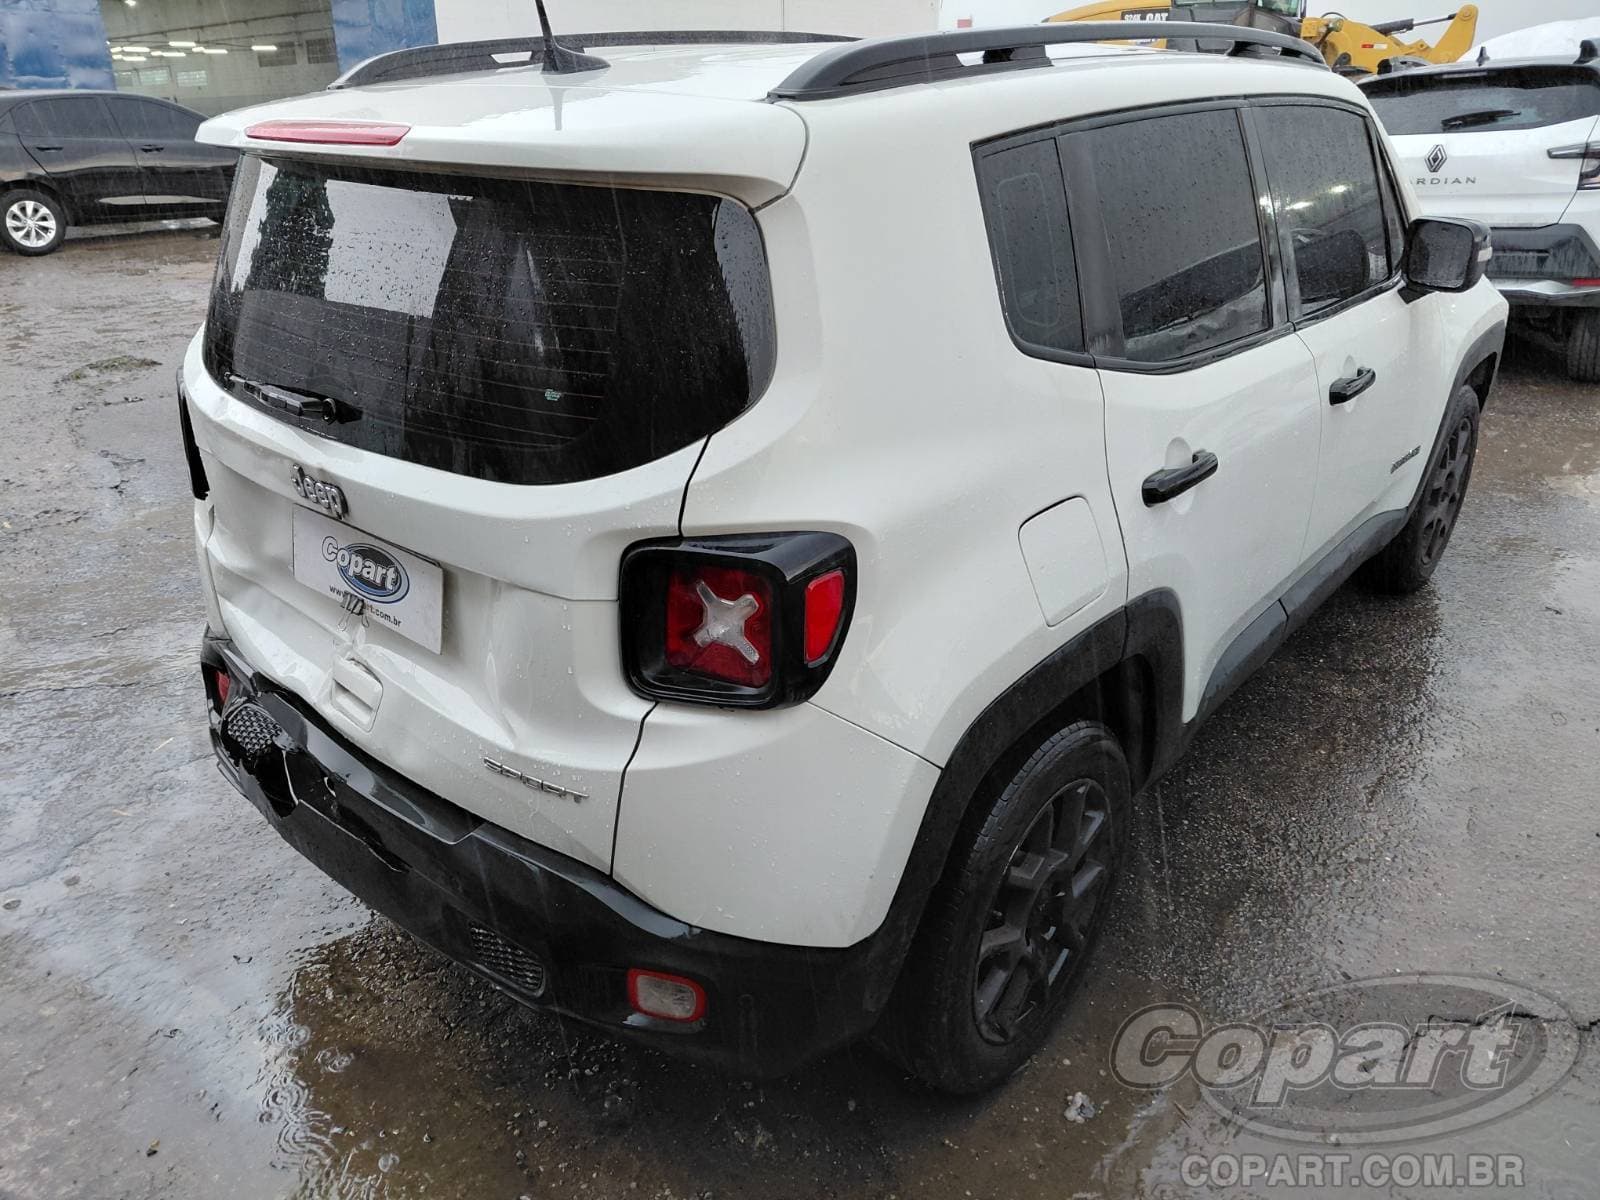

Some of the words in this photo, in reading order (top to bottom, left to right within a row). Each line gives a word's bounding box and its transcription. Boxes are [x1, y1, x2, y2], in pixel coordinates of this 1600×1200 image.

[1145, 12, 1168, 23] CAT
[291, 463, 348, 520] Jeep
[322, 536, 399, 592] Copart
